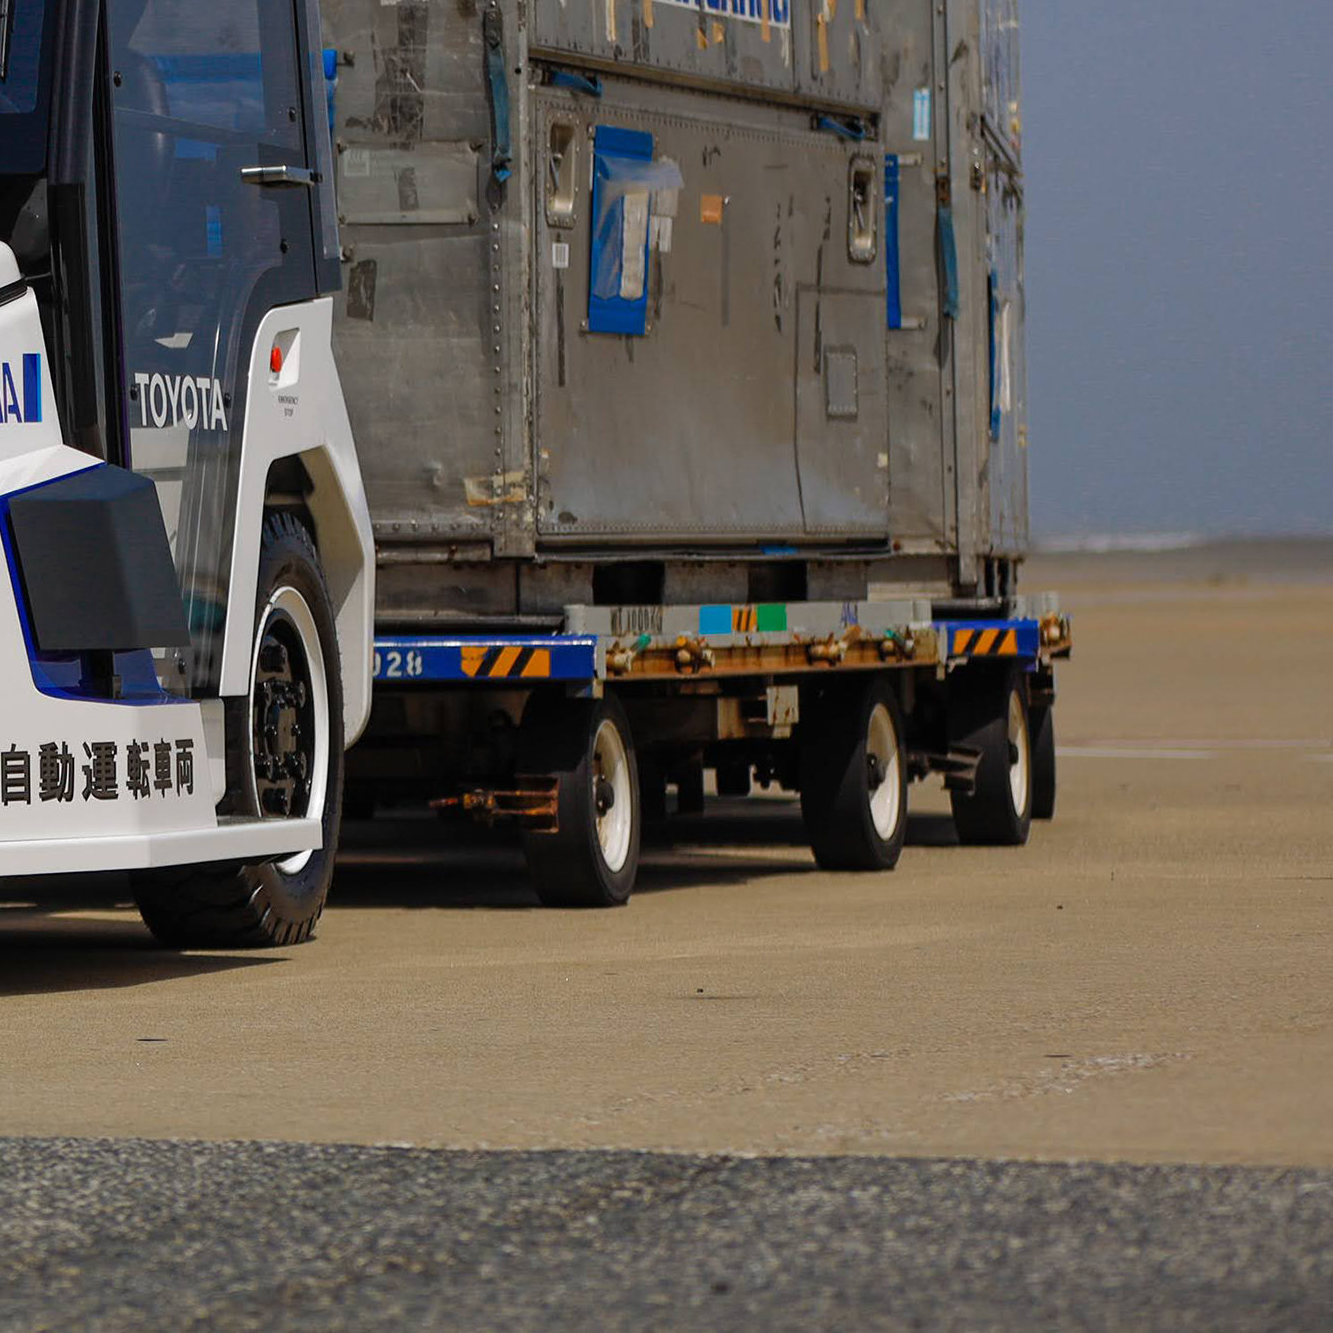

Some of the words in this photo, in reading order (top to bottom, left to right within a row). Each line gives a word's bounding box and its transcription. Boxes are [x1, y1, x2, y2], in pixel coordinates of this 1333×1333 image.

[134, 372, 228, 431] TOYOTA
[0, 738, 194, 806] 自動運転車両
